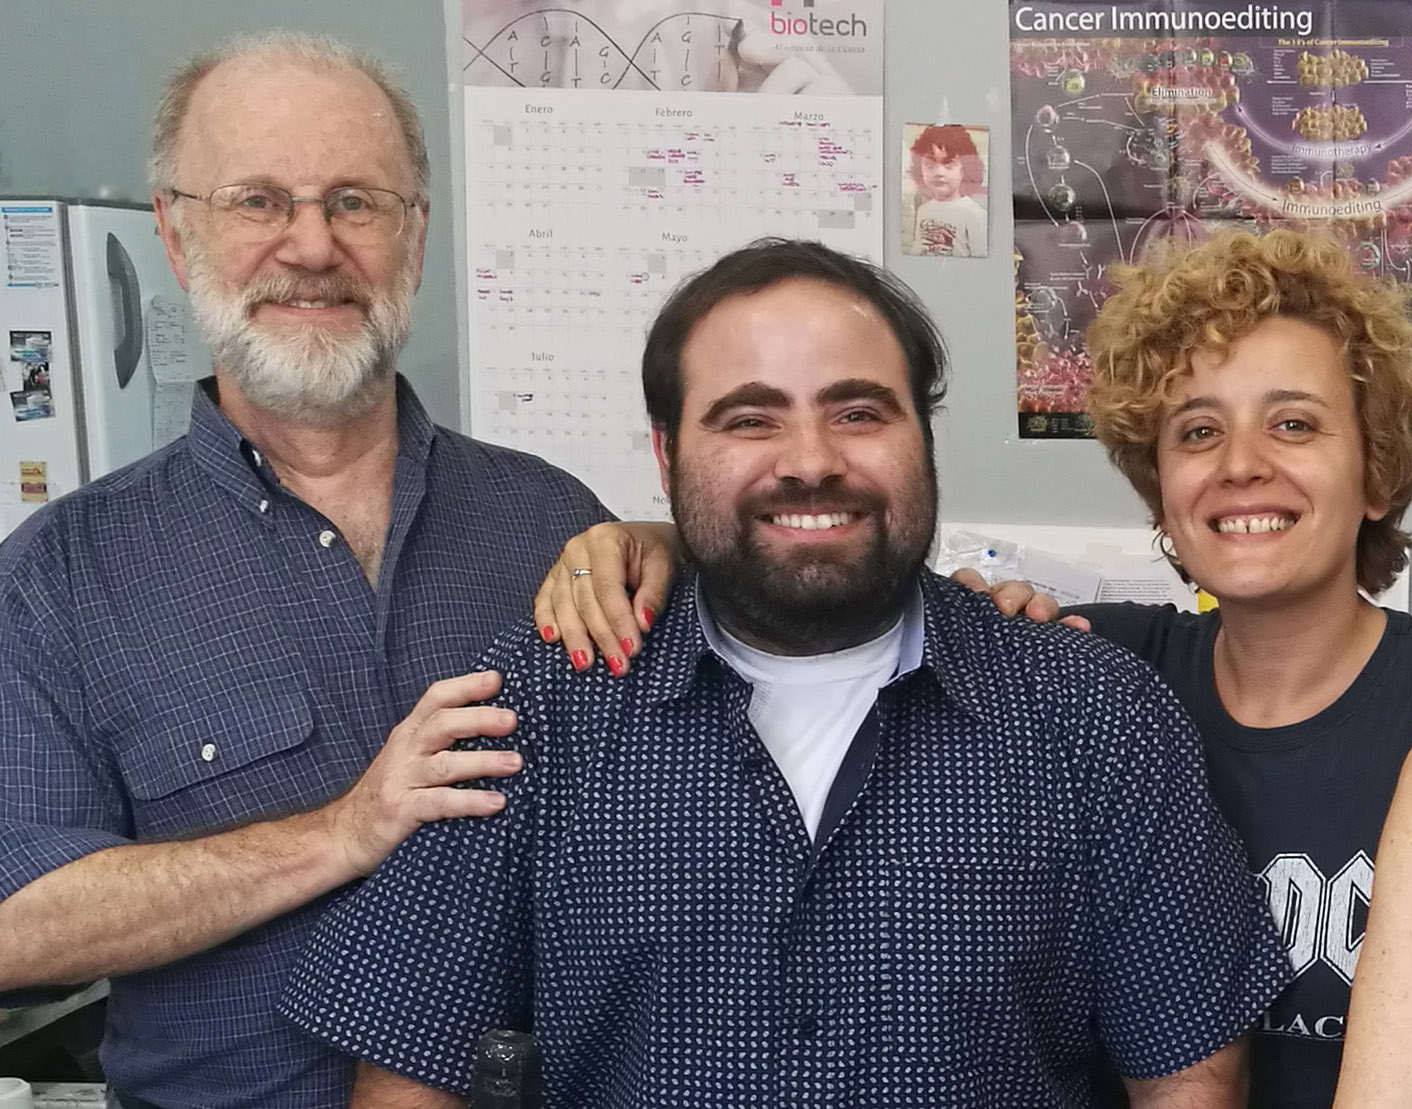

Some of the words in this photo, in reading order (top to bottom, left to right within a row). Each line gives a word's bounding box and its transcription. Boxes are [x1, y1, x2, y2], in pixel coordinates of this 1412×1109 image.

[770, 11, 867, 36] biotech
[1015, 7, 1104, 32] Cancer
[1111, 6, 1313, 35] Immunoediting
[507, 30, 519, 41] A
[651, 32, 662, 43] A
[681, 31, 692, 43] G
[540, 36, 552, 47] C
[569, 36, 581, 47] A
[599, 46, 609, 58] G
[1152, 87, 1213, 97] Elimination
[525, 104, 553, 114] Enero
[655, 108, 693, 118] Febrero
[793, 112, 824, 121] Marzo
[1282, 199, 1382, 216] Immunoediting
[529, 229, 553, 239] Abril
[662, 232, 688, 243] Mayo
